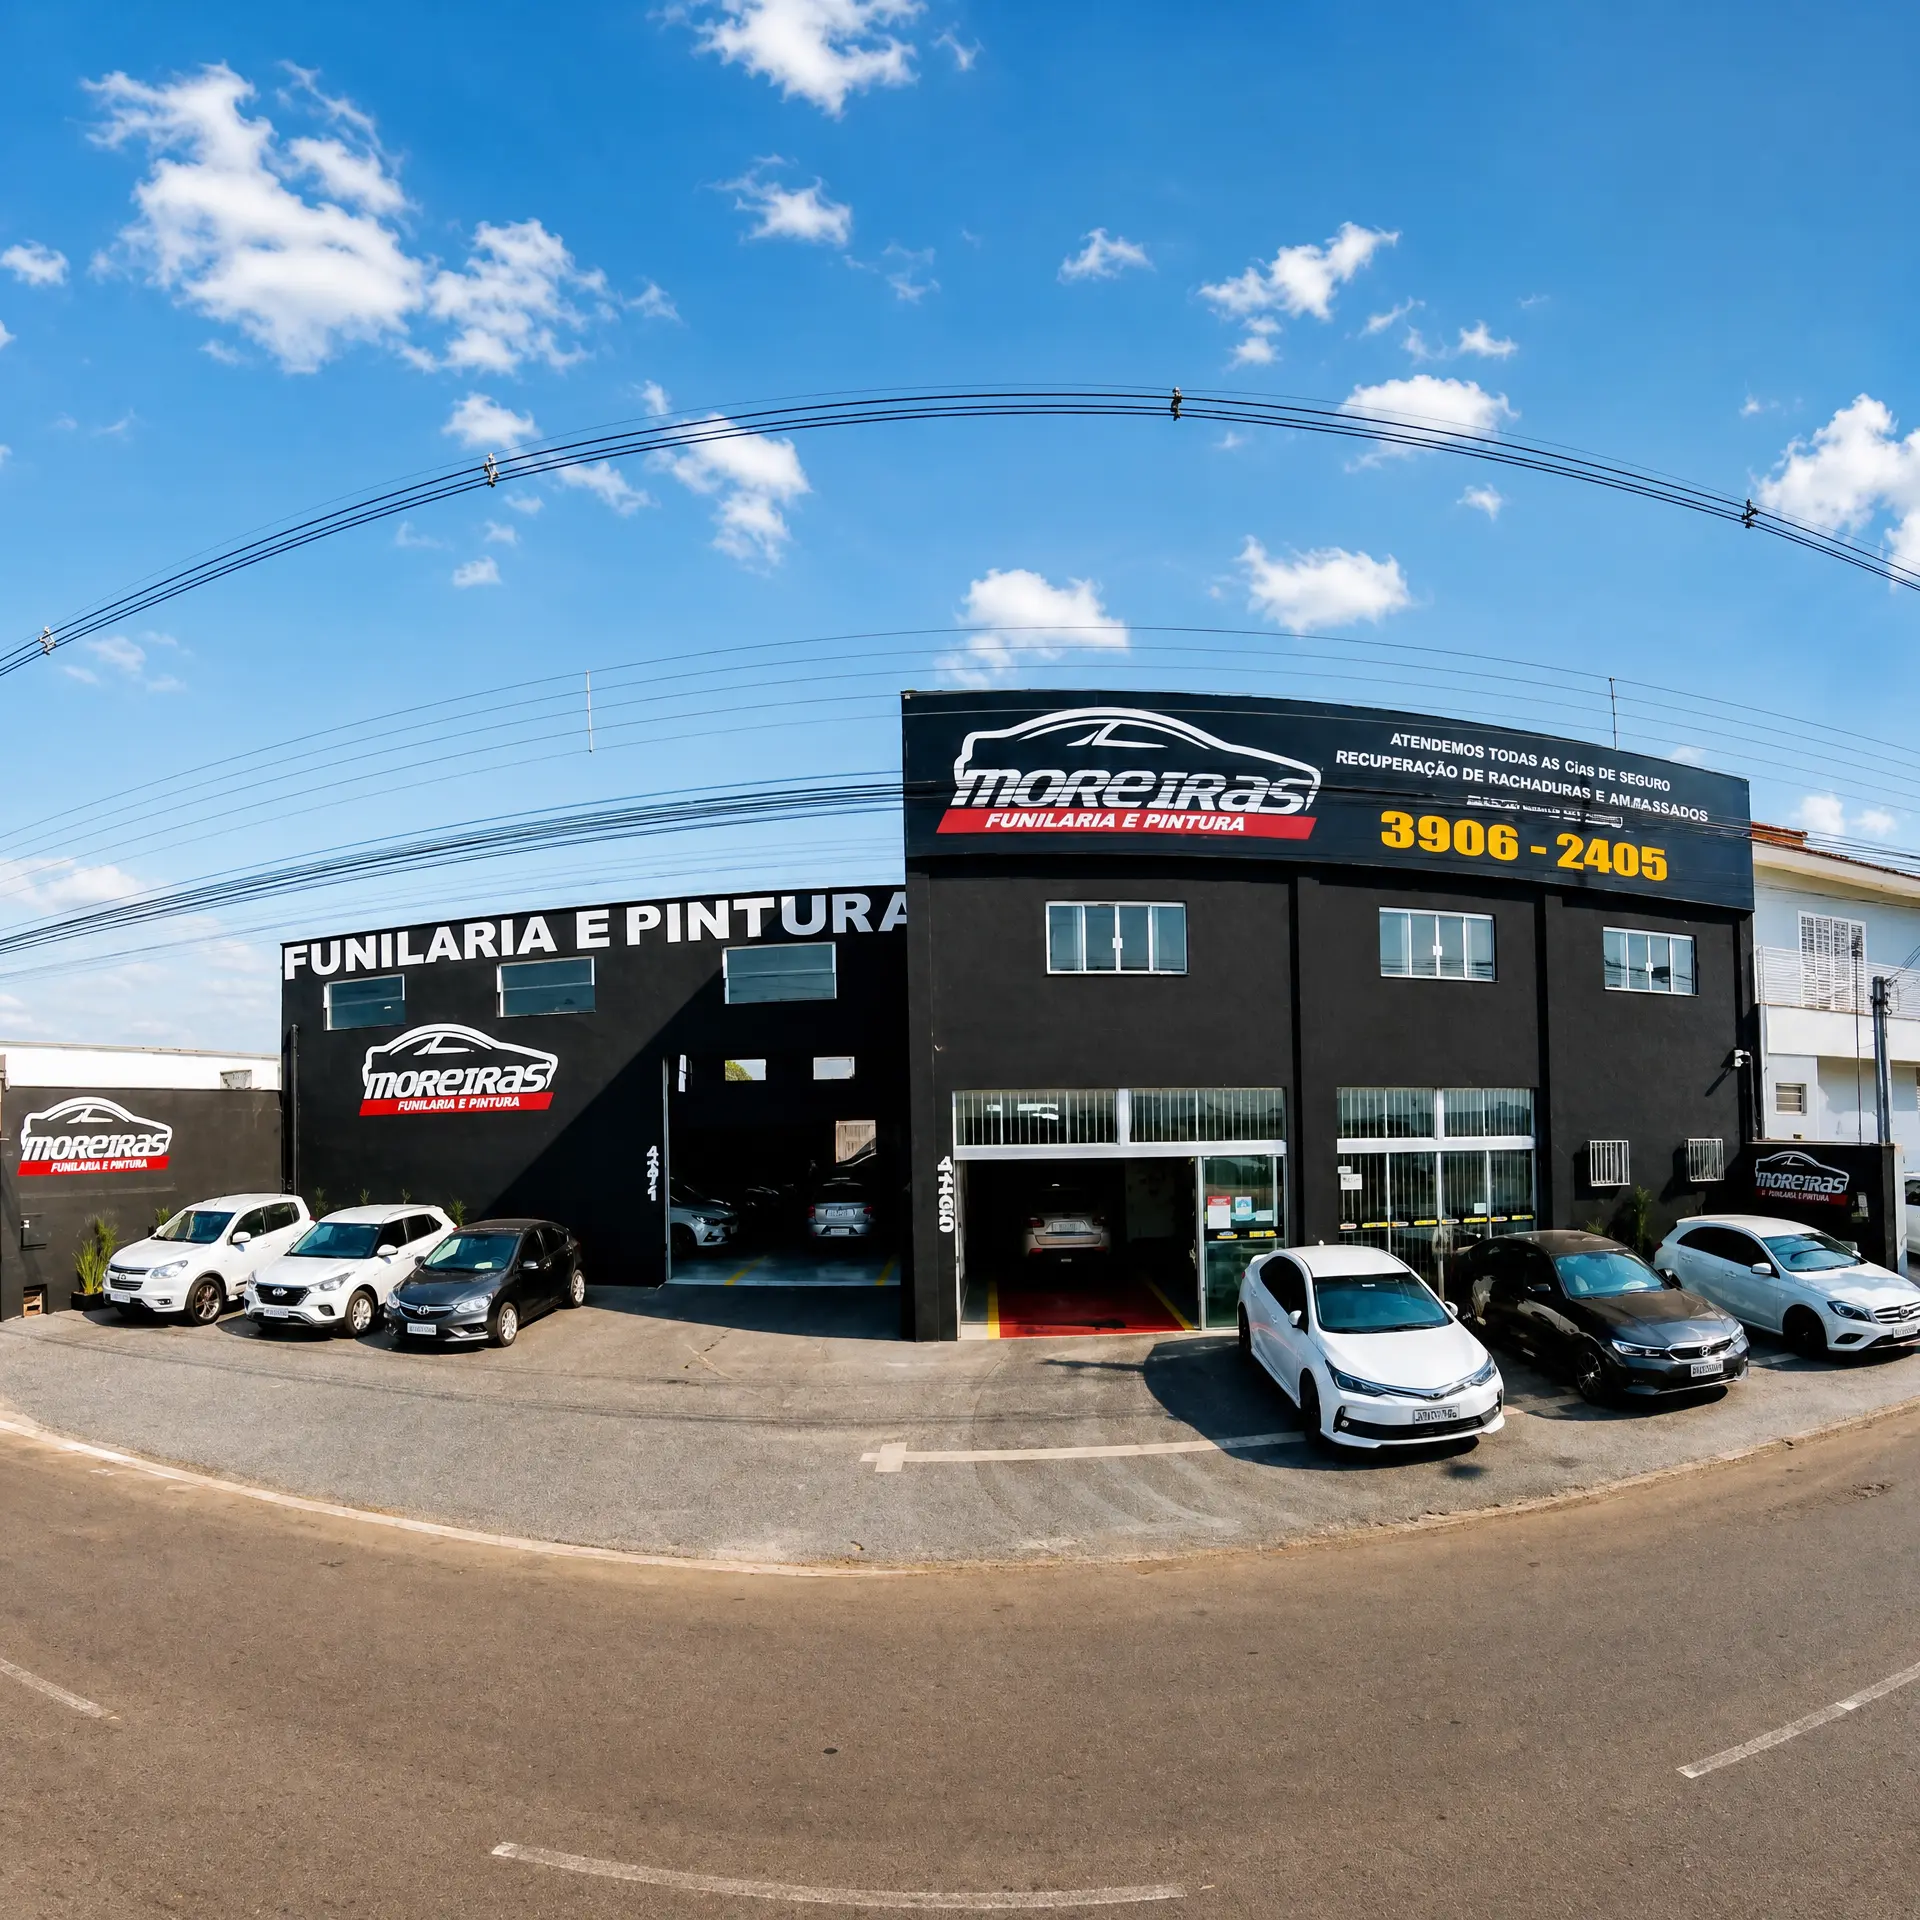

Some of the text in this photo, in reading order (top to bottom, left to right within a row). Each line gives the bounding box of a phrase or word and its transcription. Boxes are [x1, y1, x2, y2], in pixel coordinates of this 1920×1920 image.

[1336, 749, 1458, 780] RECUPERAÇÃO
[1462, 766, 1485, 783] DE
[1488, 771, 1591, 799] RACHADURAS
[1595, 789, 1605, 803] E
[1390, 732, 1484, 759] ATENDEMOS
[1489, 747, 1538, 767] TODAS
[1541, 756, 1560, 771] AS
[1599, 767, 1616, 781] DE
[1619, 771, 1671, 792] SEGURO
[985, 813, 1245, 832] FUNILARIA E PINTURA
[1380, 810, 1519, 861] 3906
[1556, 833, 1669, 882] 2405
[283, 892, 907, 980] FUNILARIA E PINTURA
[397, 1096, 520, 1112] FUNILARIA E PINTURA
[50, 1158, 148, 1173] FUNILARIA E PINTURA
